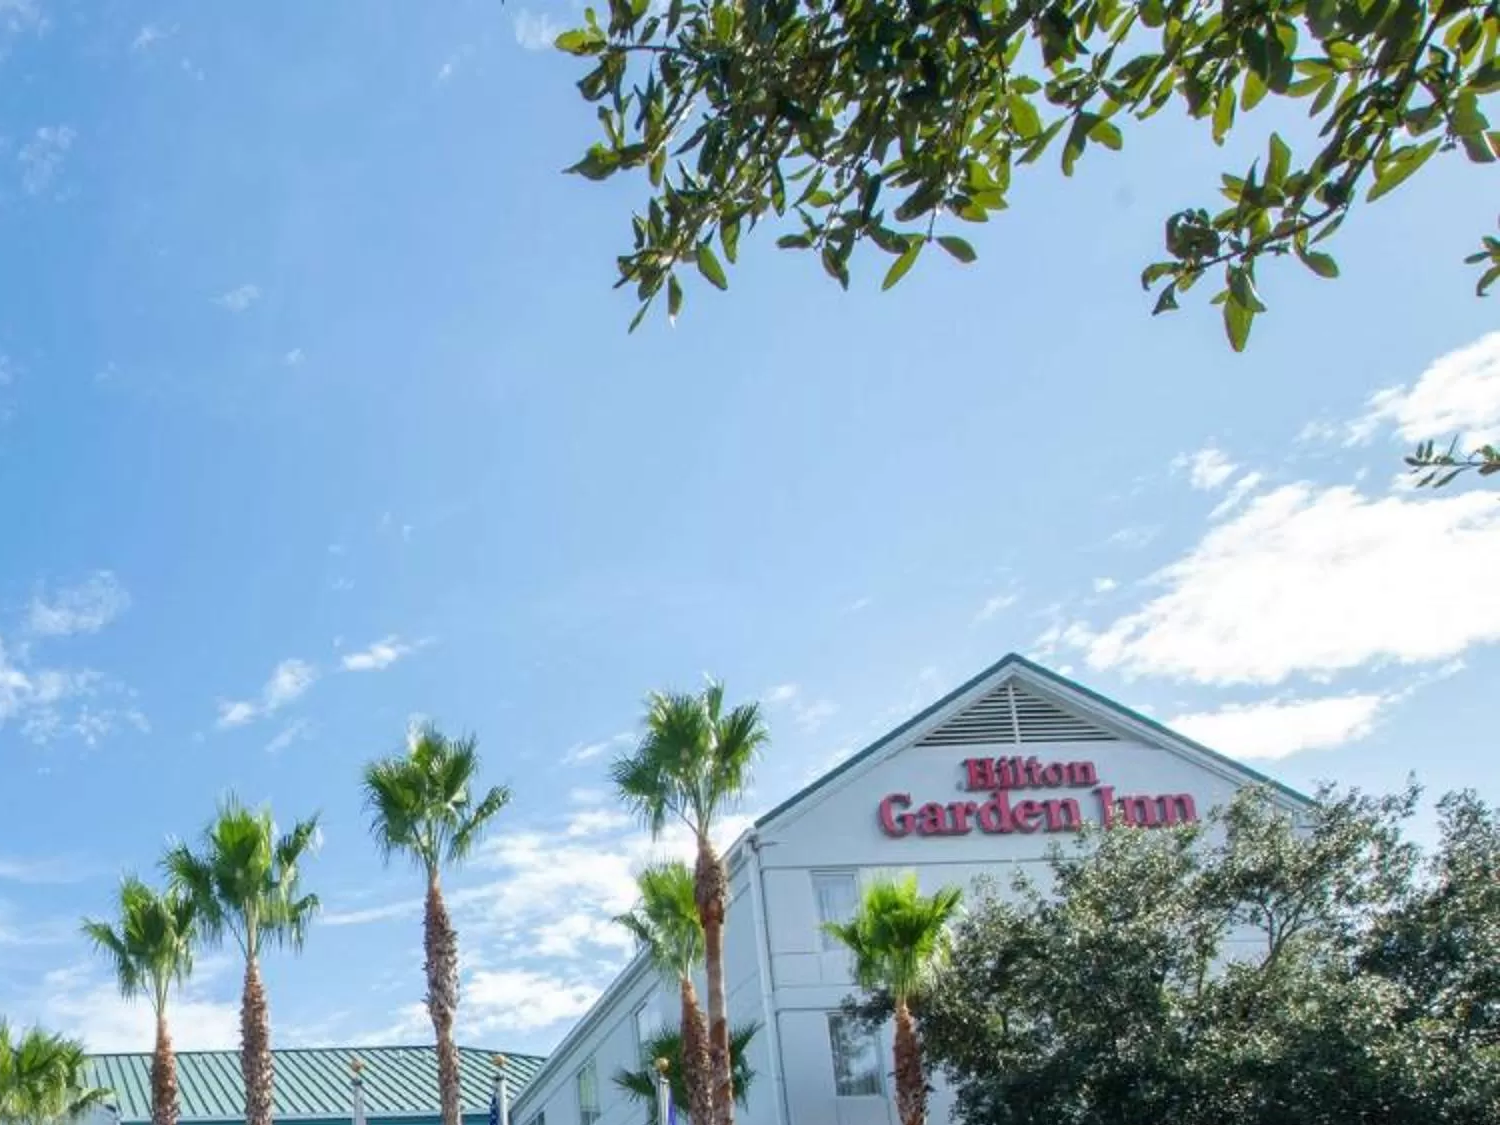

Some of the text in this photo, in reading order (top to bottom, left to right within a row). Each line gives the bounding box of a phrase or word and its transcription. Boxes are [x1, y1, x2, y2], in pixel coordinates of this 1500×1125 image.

[963, 755, 1099, 792] Hilton
[877, 784, 1200, 838] Garden Inn
